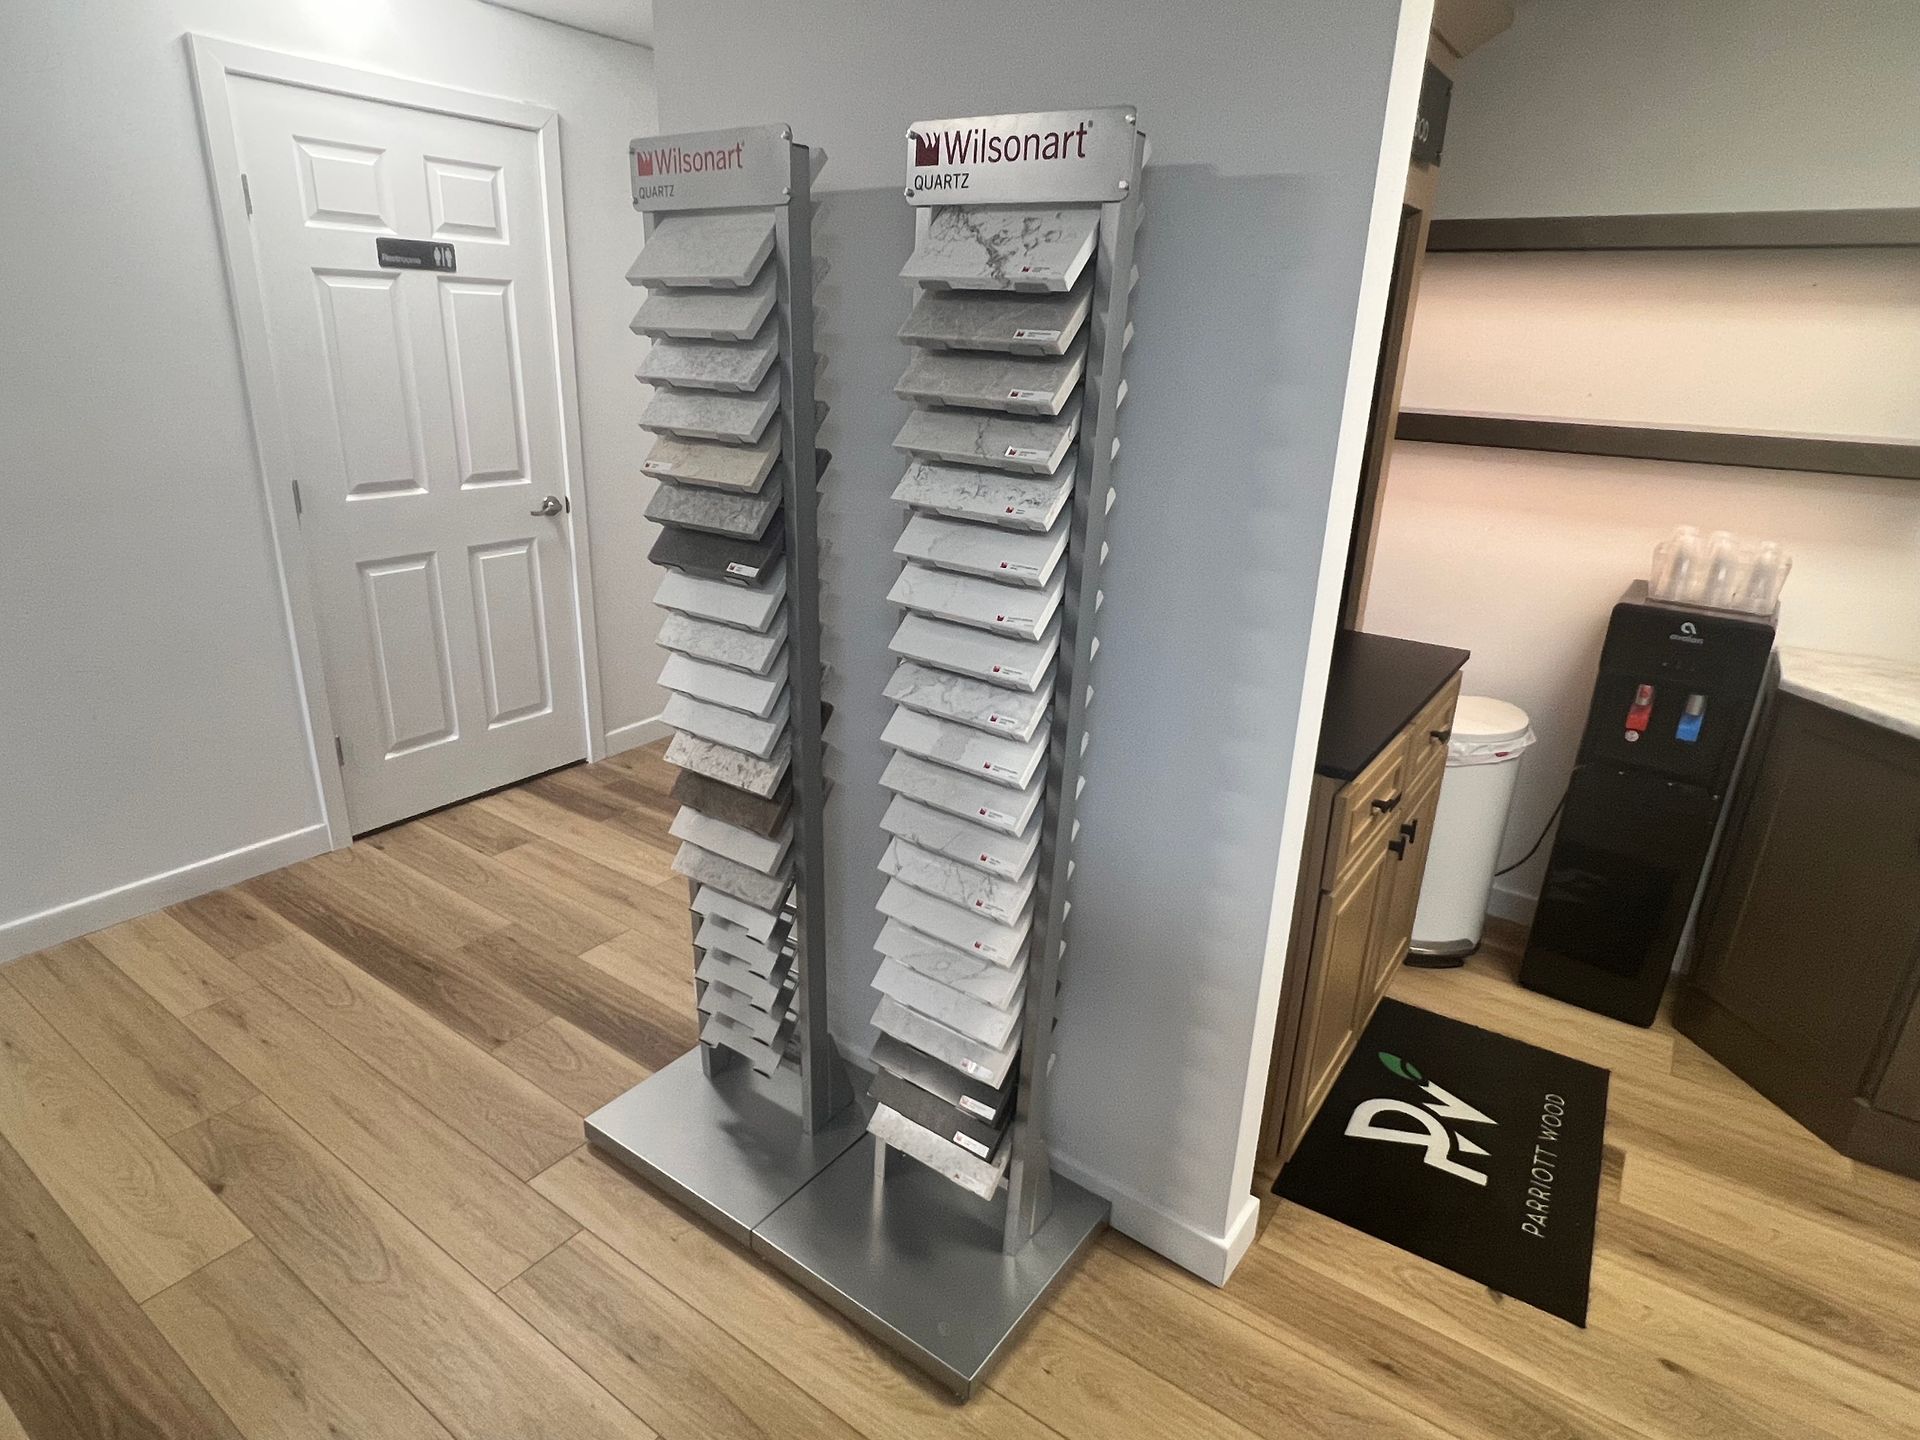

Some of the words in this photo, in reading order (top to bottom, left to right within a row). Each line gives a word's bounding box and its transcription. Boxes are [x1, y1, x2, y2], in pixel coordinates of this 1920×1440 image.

[654, 142, 743, 175] Wilsonart
[944, 122, 1088, 165] Wilsonart
[638, 184, 675, 200] QUARTZ
[914, 173, 969, 191] QUARTZ
[1539, 1093, 1566, 1141] WOOD
[1521, 1144, 1560, 1239] PARRIOTT
